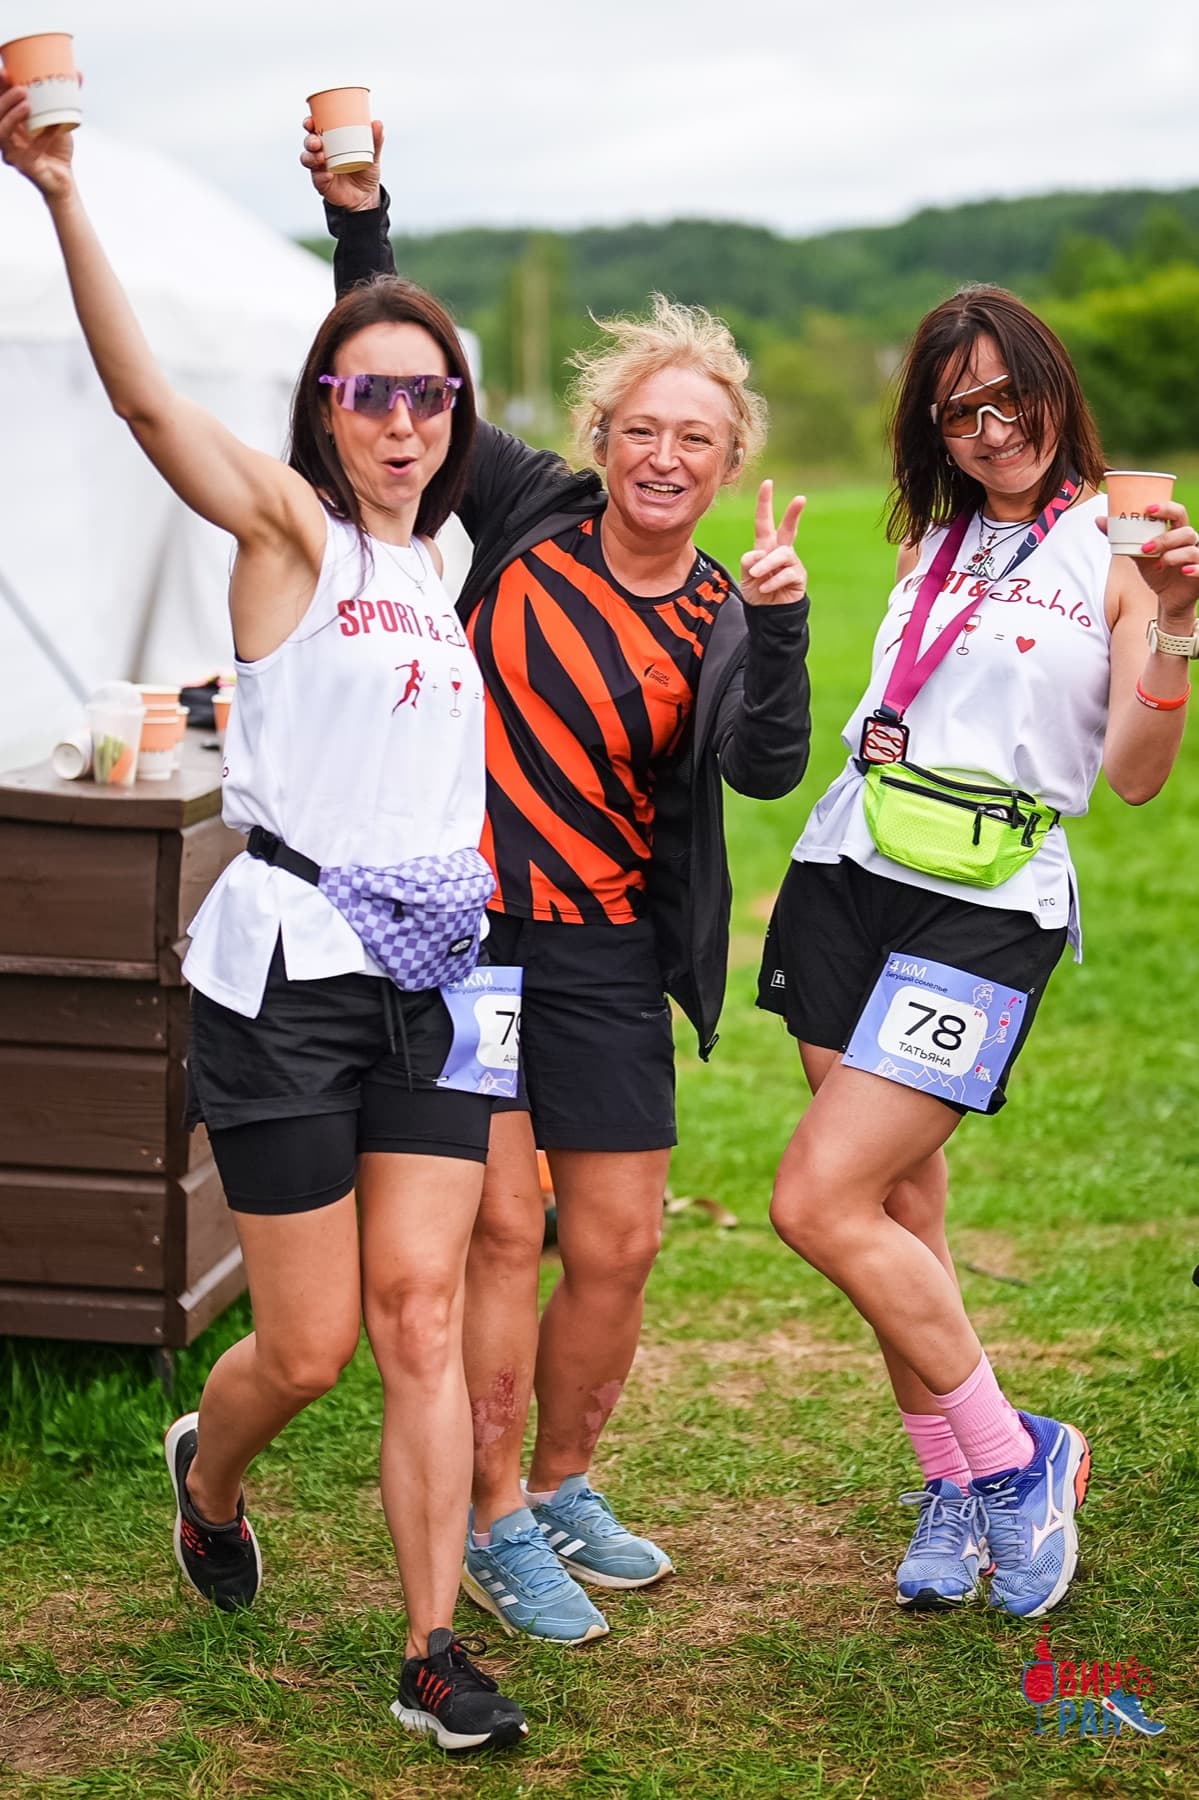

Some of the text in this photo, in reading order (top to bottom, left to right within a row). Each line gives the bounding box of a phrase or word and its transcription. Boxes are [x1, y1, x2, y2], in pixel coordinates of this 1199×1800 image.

[337, 599, 422, 637] SPORT
[424, 615, 442, 642] &
[967, 579, 991, 598] &
[989, 578, 1092, 628] Buhlo
[888, 960, 900, 973] 4
[914, 978, 949, 993] сомелье
[904, 1001, 967, 1051] 78
[899, 1041, 951, 1068] ТАТЬЯНА
